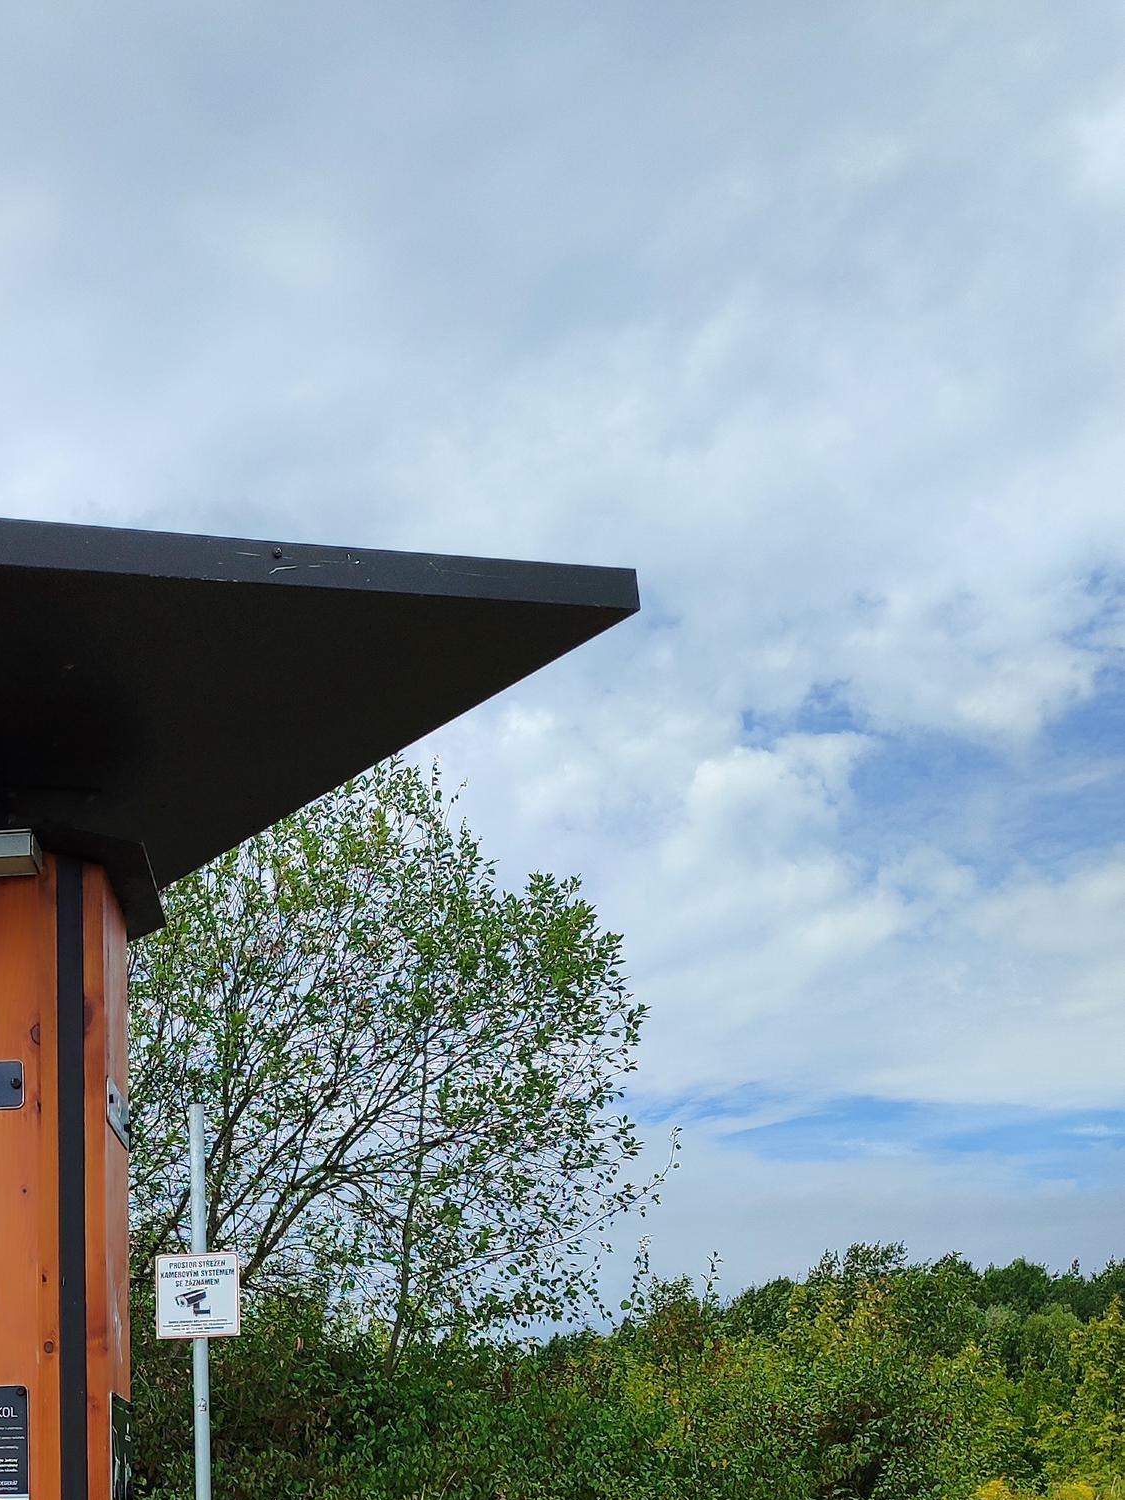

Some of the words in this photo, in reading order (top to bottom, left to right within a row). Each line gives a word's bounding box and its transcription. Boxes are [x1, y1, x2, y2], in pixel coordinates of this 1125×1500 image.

[198, 1259, 226, 1268] STŘEŽEN
[160, 1269, 199, 1279] KAMEROVÝM
[185, 1278, 220, 1287] ZÁZNAMEM
